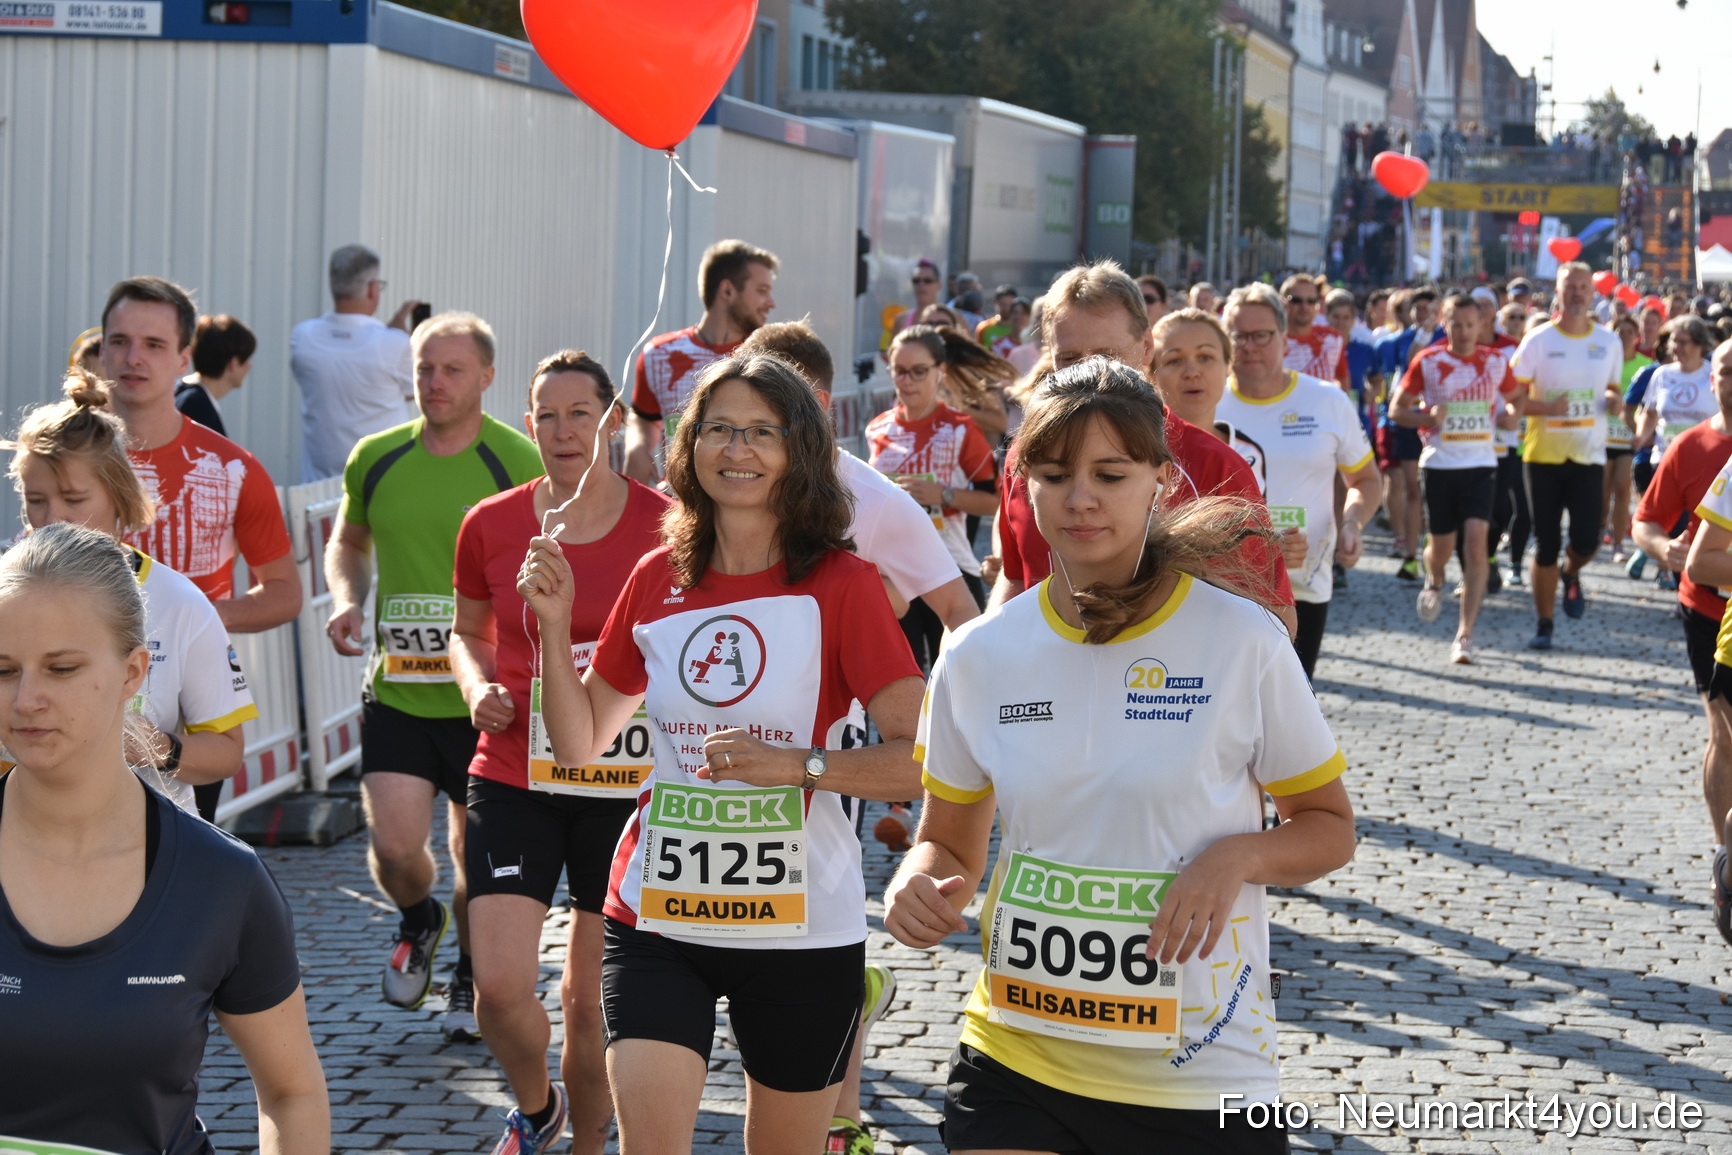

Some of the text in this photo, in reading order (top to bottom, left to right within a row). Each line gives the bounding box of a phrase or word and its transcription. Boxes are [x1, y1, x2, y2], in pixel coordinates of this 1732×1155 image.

[1480, 189, 1549, 206] START
[1271, 510, 1297, 523] CK
[663, 596, 685, 605] erima
[401, 660, 452, 672] MARKU
[1128, 666, 1201, 689] 20 JAHRE
[1126, 692, 1212, 705] Neumarkter
[1000, 702, 1053, 719] BOCK
[1124, 708, 1193, 723] Stadtlauf
[750, 724, 793, 743] HERZ
[681, 744, 702, 755] Hec
[551, 766, 639, 784] MELANIE
[659, 790, 789, 827] BOCK
[791, 843, 799, 852] S
[657, 837, 787, 886] 5125
[1012, 863, 1164, 916] BOCK
[665, 898, 777, 920] CLAUDIA
[1007, 917, 1159, 986] 5096
[0, 973, 22, 986] ÜNCH
[127, 974, 185, 985] KILIMANJARO
[1006, 984, 1158, 1025] ELISABETH
[1203, 989, 1240, 1045] September
[1237, 964, 1252, 991] 2019
